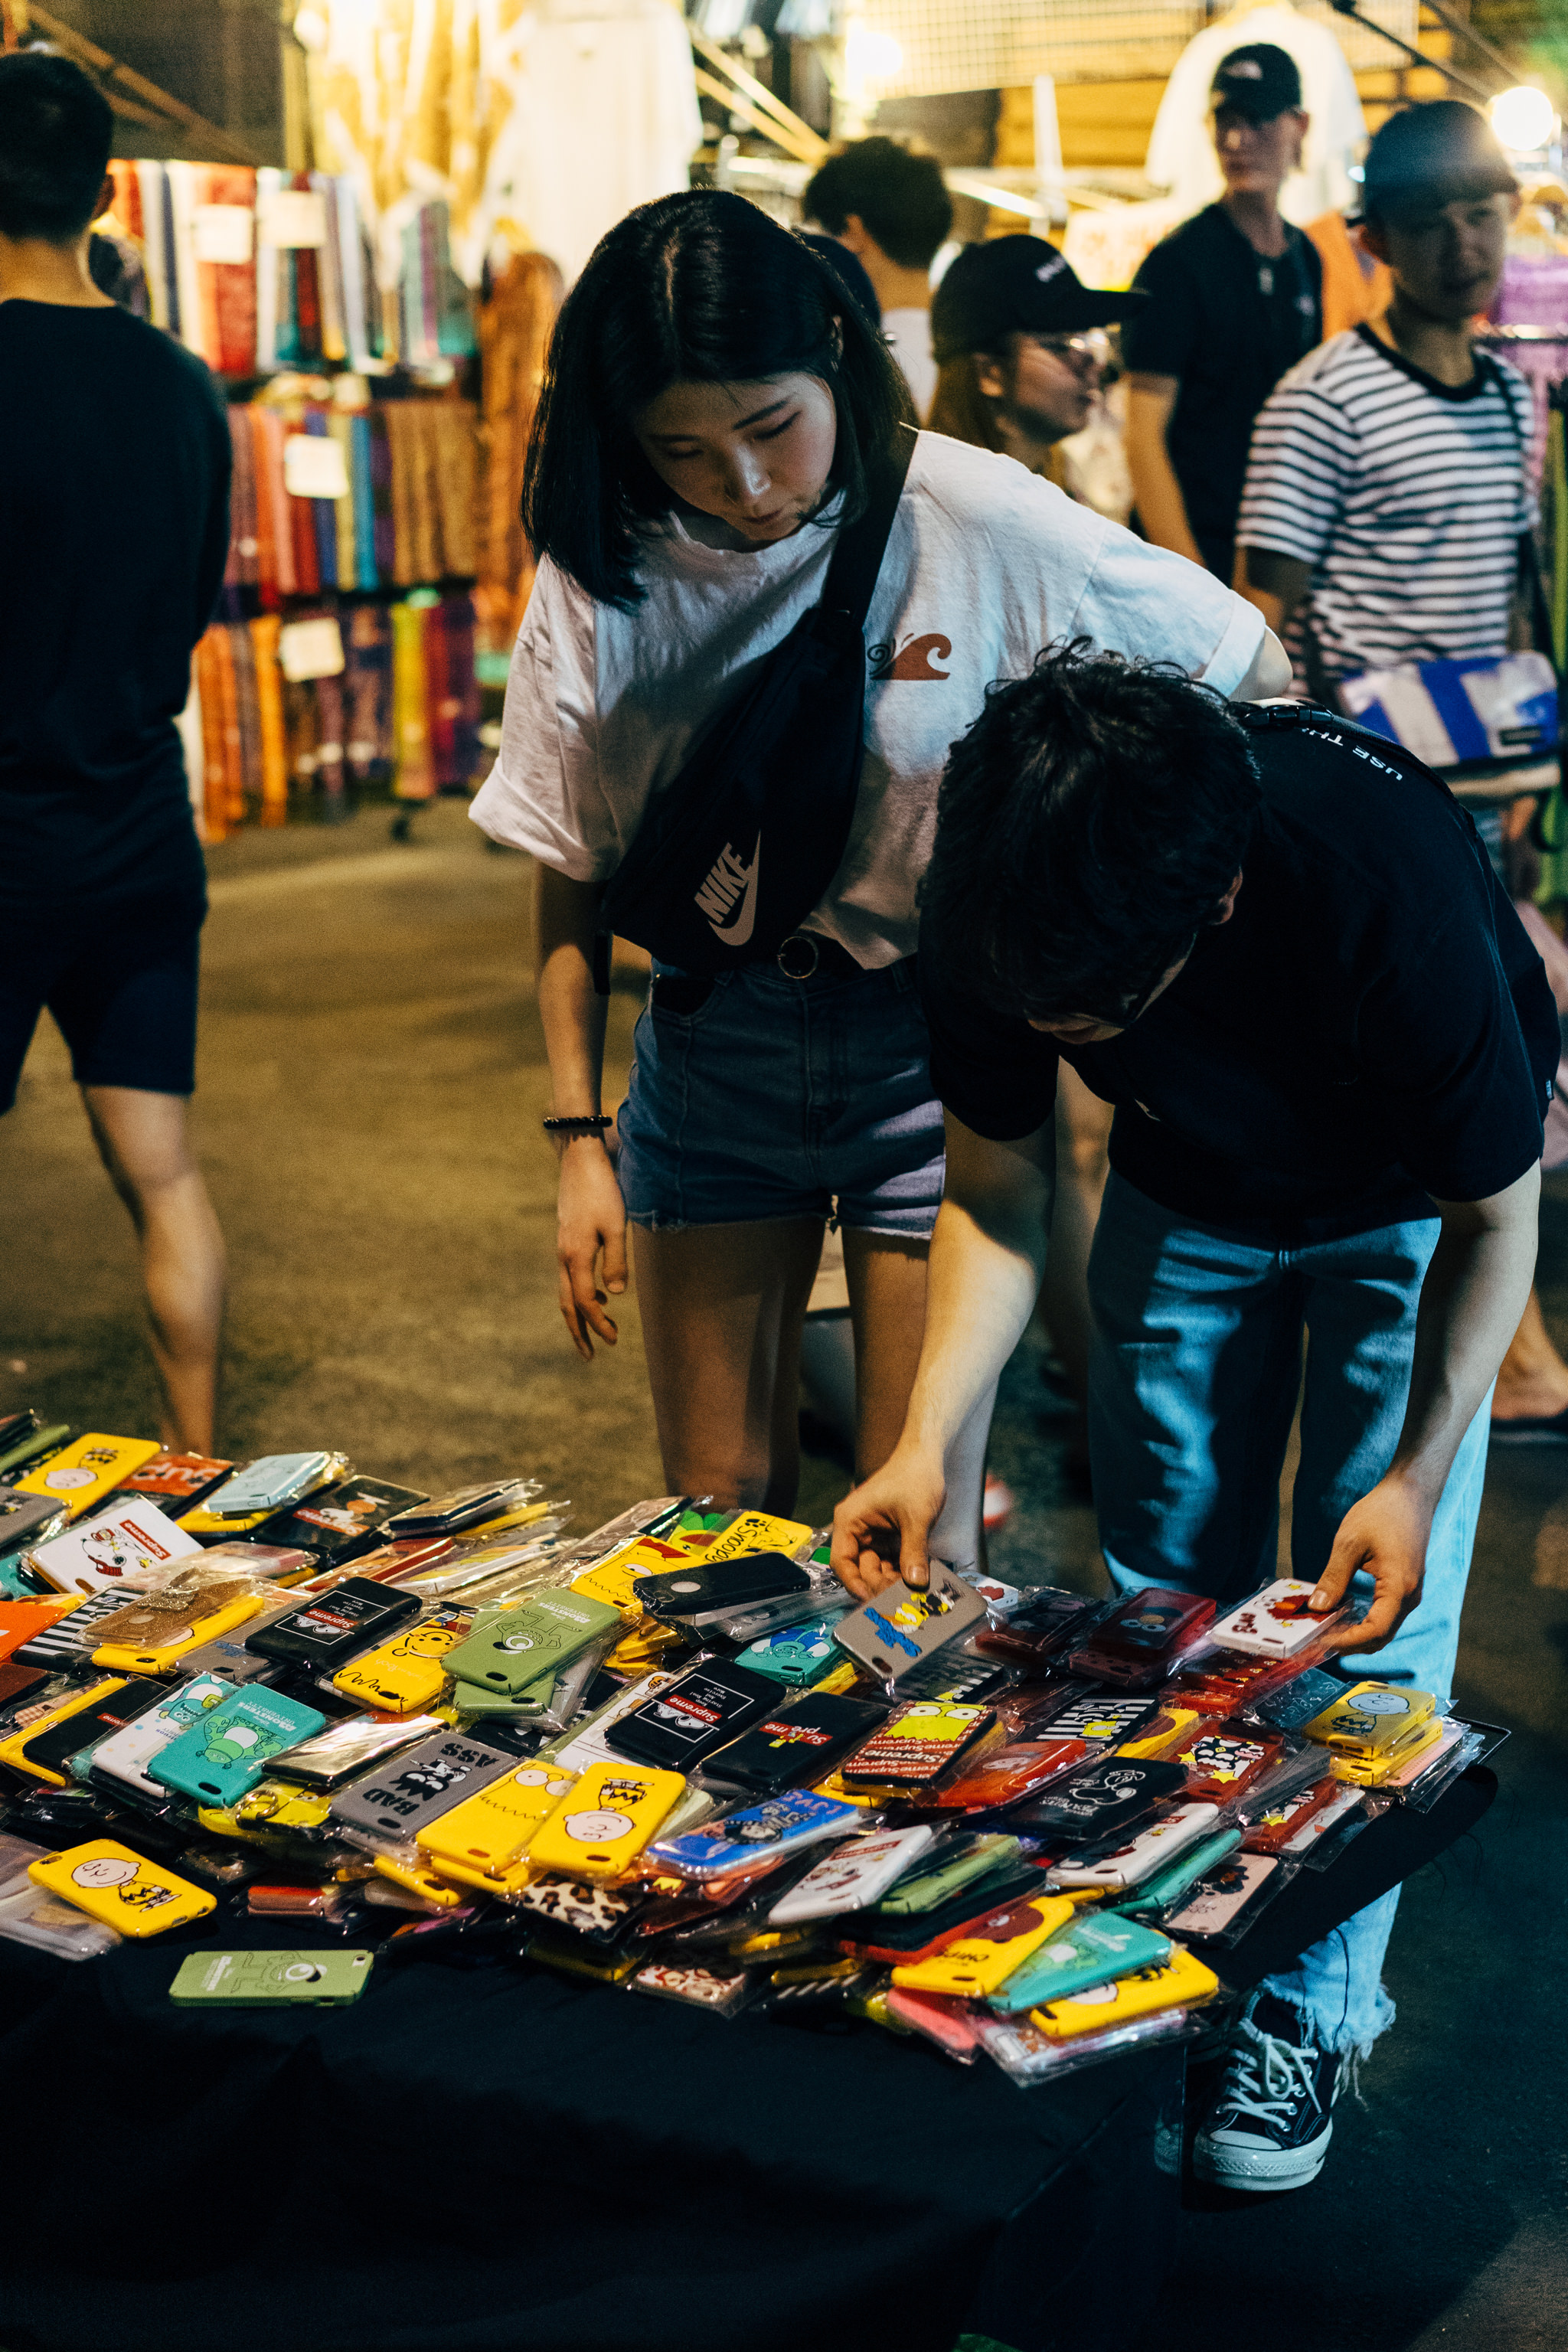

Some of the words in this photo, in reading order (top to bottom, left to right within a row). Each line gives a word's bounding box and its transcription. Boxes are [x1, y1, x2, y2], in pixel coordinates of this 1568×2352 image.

[1302, 727, 1344, 746] TH
[1352, 745, 1403, 781] USE
[694, 842, 753, 925] NIKE
[123, 1522, 167, 1560] Supreme
[309, 1609, 355, 1629] Supreme
[548, 1600, 591, 1619] UNIVERSITY
[247, 1700, 296, 1725] UNIVERSITY
[668, 1696, 719, 1723] Supreme
[765, 1723, 789, 1733] me
[791, 1725, 822, 1734] pre
[807, 1734, 828, 1745] Su
[439, 1743, 500, 1769] ASS
[864, 1749, 941, 1763] Supreme
[362, 1787, 420, 1816] BAD
